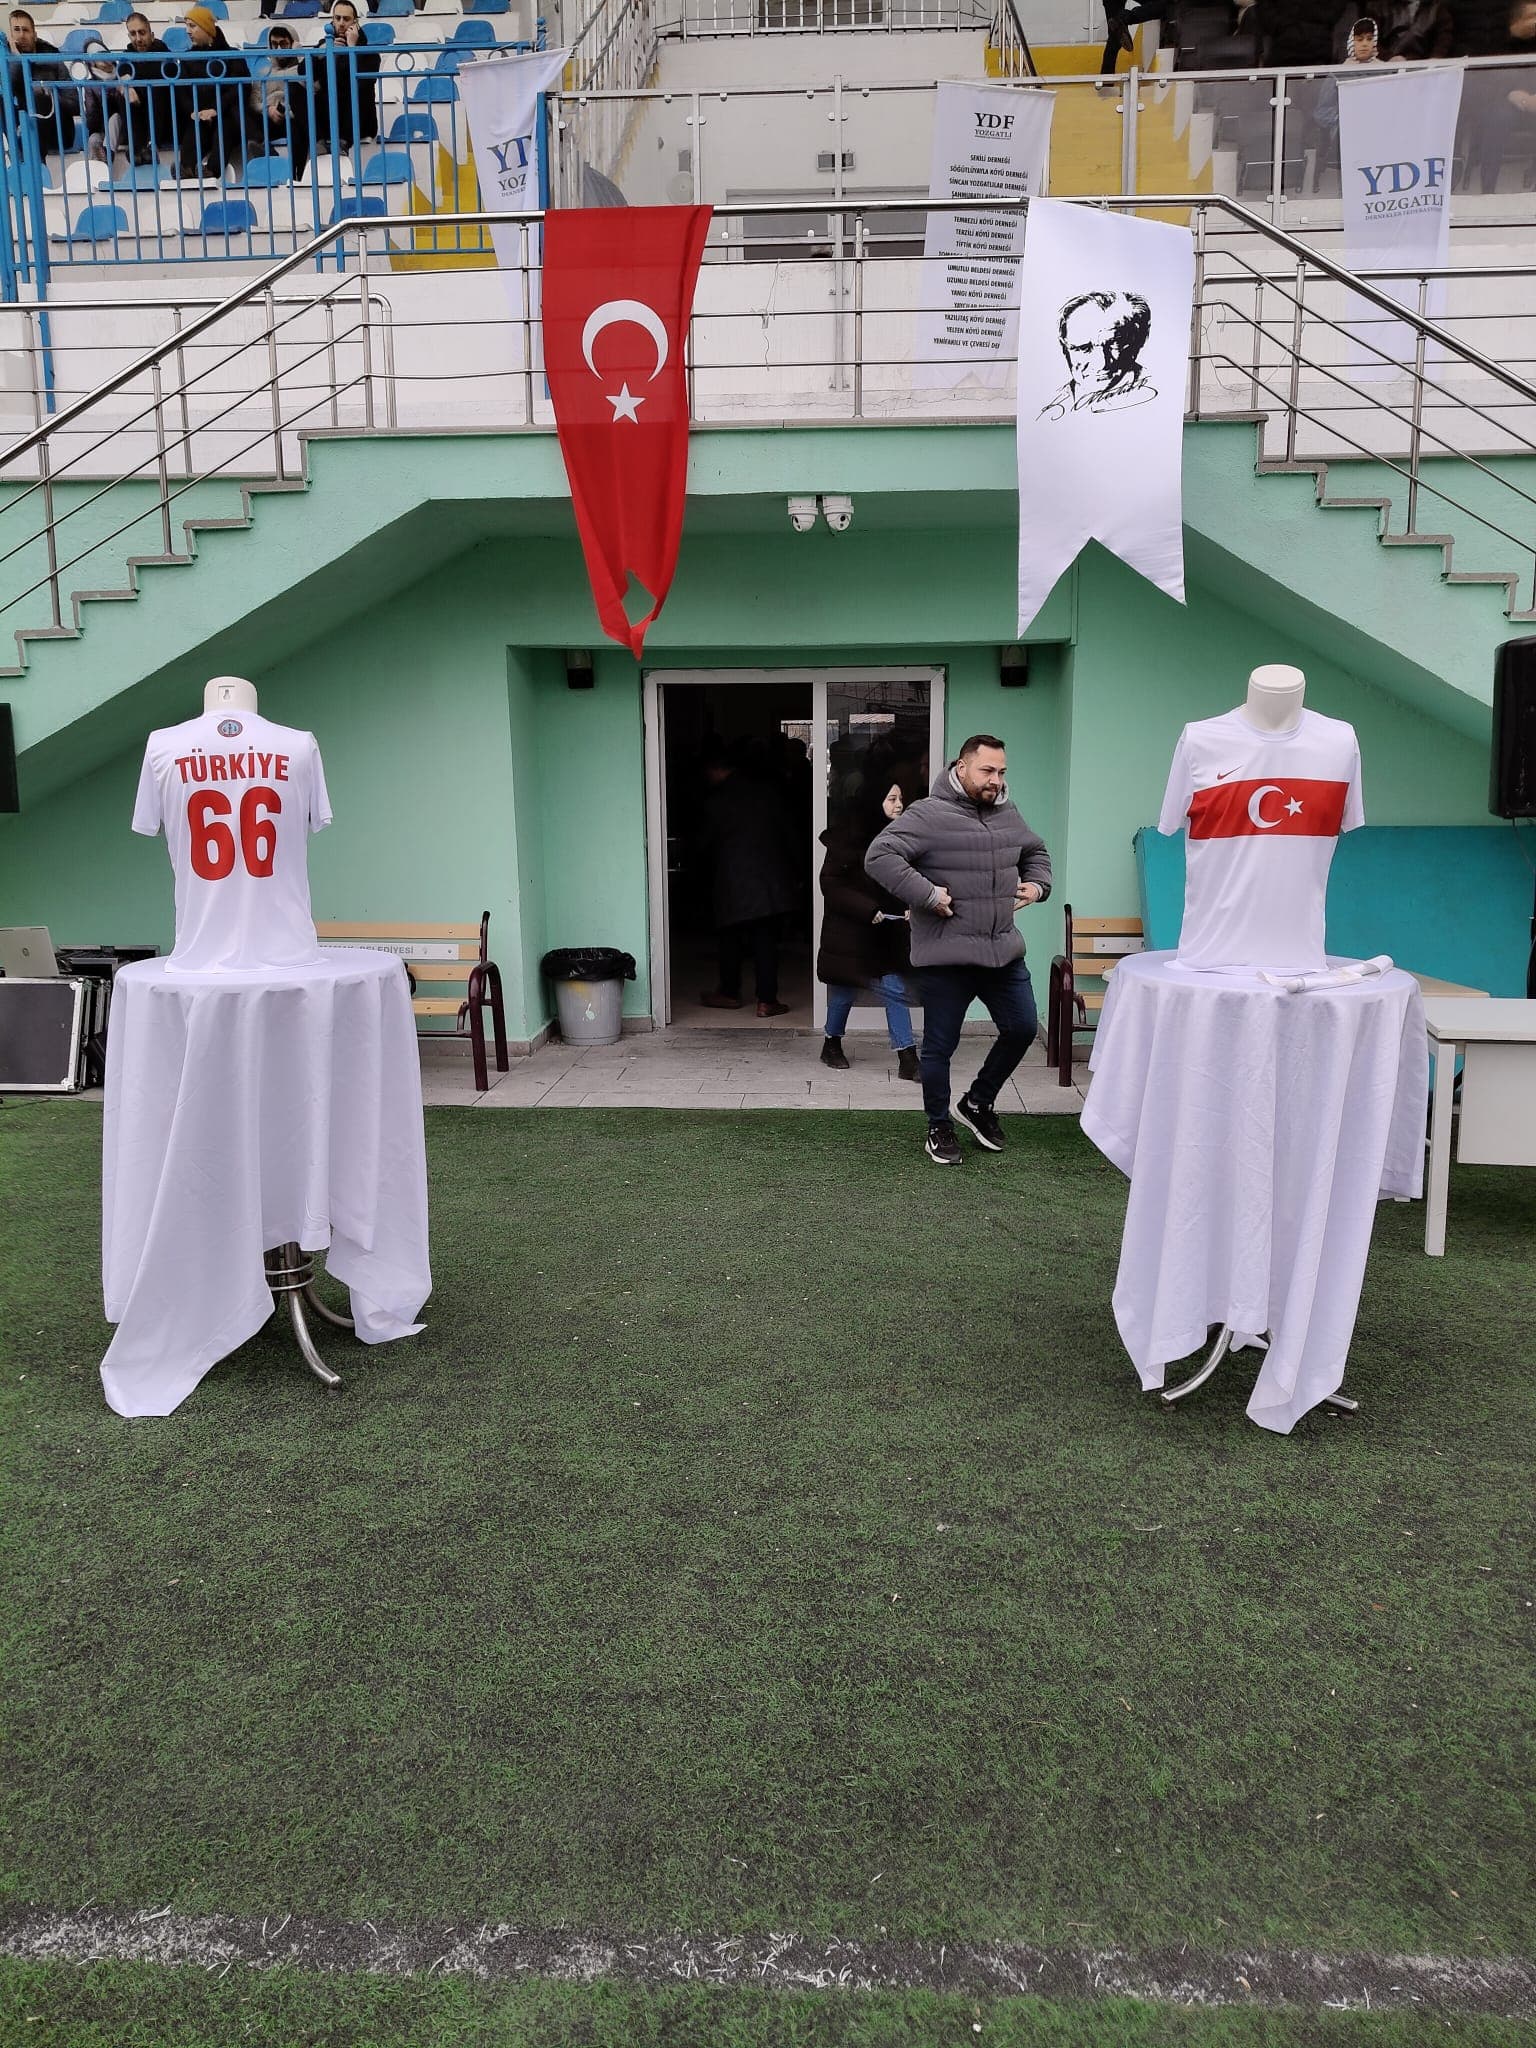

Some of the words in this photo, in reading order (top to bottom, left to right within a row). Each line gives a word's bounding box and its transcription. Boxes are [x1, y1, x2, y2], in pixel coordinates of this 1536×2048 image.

[974, 112, 1015, 129] YDF
[974, 129, 1012, 138] YOZGATLI
[987, 156, 1011, 164] DERNEĞİ
[989, 168, 1004, 176] KÖYÜ
[1005, 170, 1029, 179] DERNEĞİ
[1357, 157, 1446, 196] YDF
[1004, 183, 1028, 192] DERNEĞİ
[1364, 194, 1444, 214] YOZGATLI
[979, 218, 994, 226] KÖYÜ
[994, 219, 1018, 228] DERNEĞİ
[975, 229, 990, 238] KÖYÜ
[990, 231, 1014, 240] DERNEĞİ
[972, 242, 988, 250] KÖYÜ
[988, 244, 1012, 252] DERNEĞİ
[970, 266, 992, 275] BELDESİ
[992, 268, 1016, 276] DERNEĞİ
[969, 278, 990, 286] BELDESİ
[990, 280, 1014, 289] DERNEĞİ
[968, 290, 983, 298] KÖYÜ
[983, 292, 1007, 300] DERNEĞİ
[969, 315, 985, 323] KÖYÜ
[965, 327, 980, 335] KÖYÜ
[969, 340, 990, 349] ÇEVRESİ
[175, 745, 290, 784] TÜRKİYE
[187, 785, 282, 881] 66
